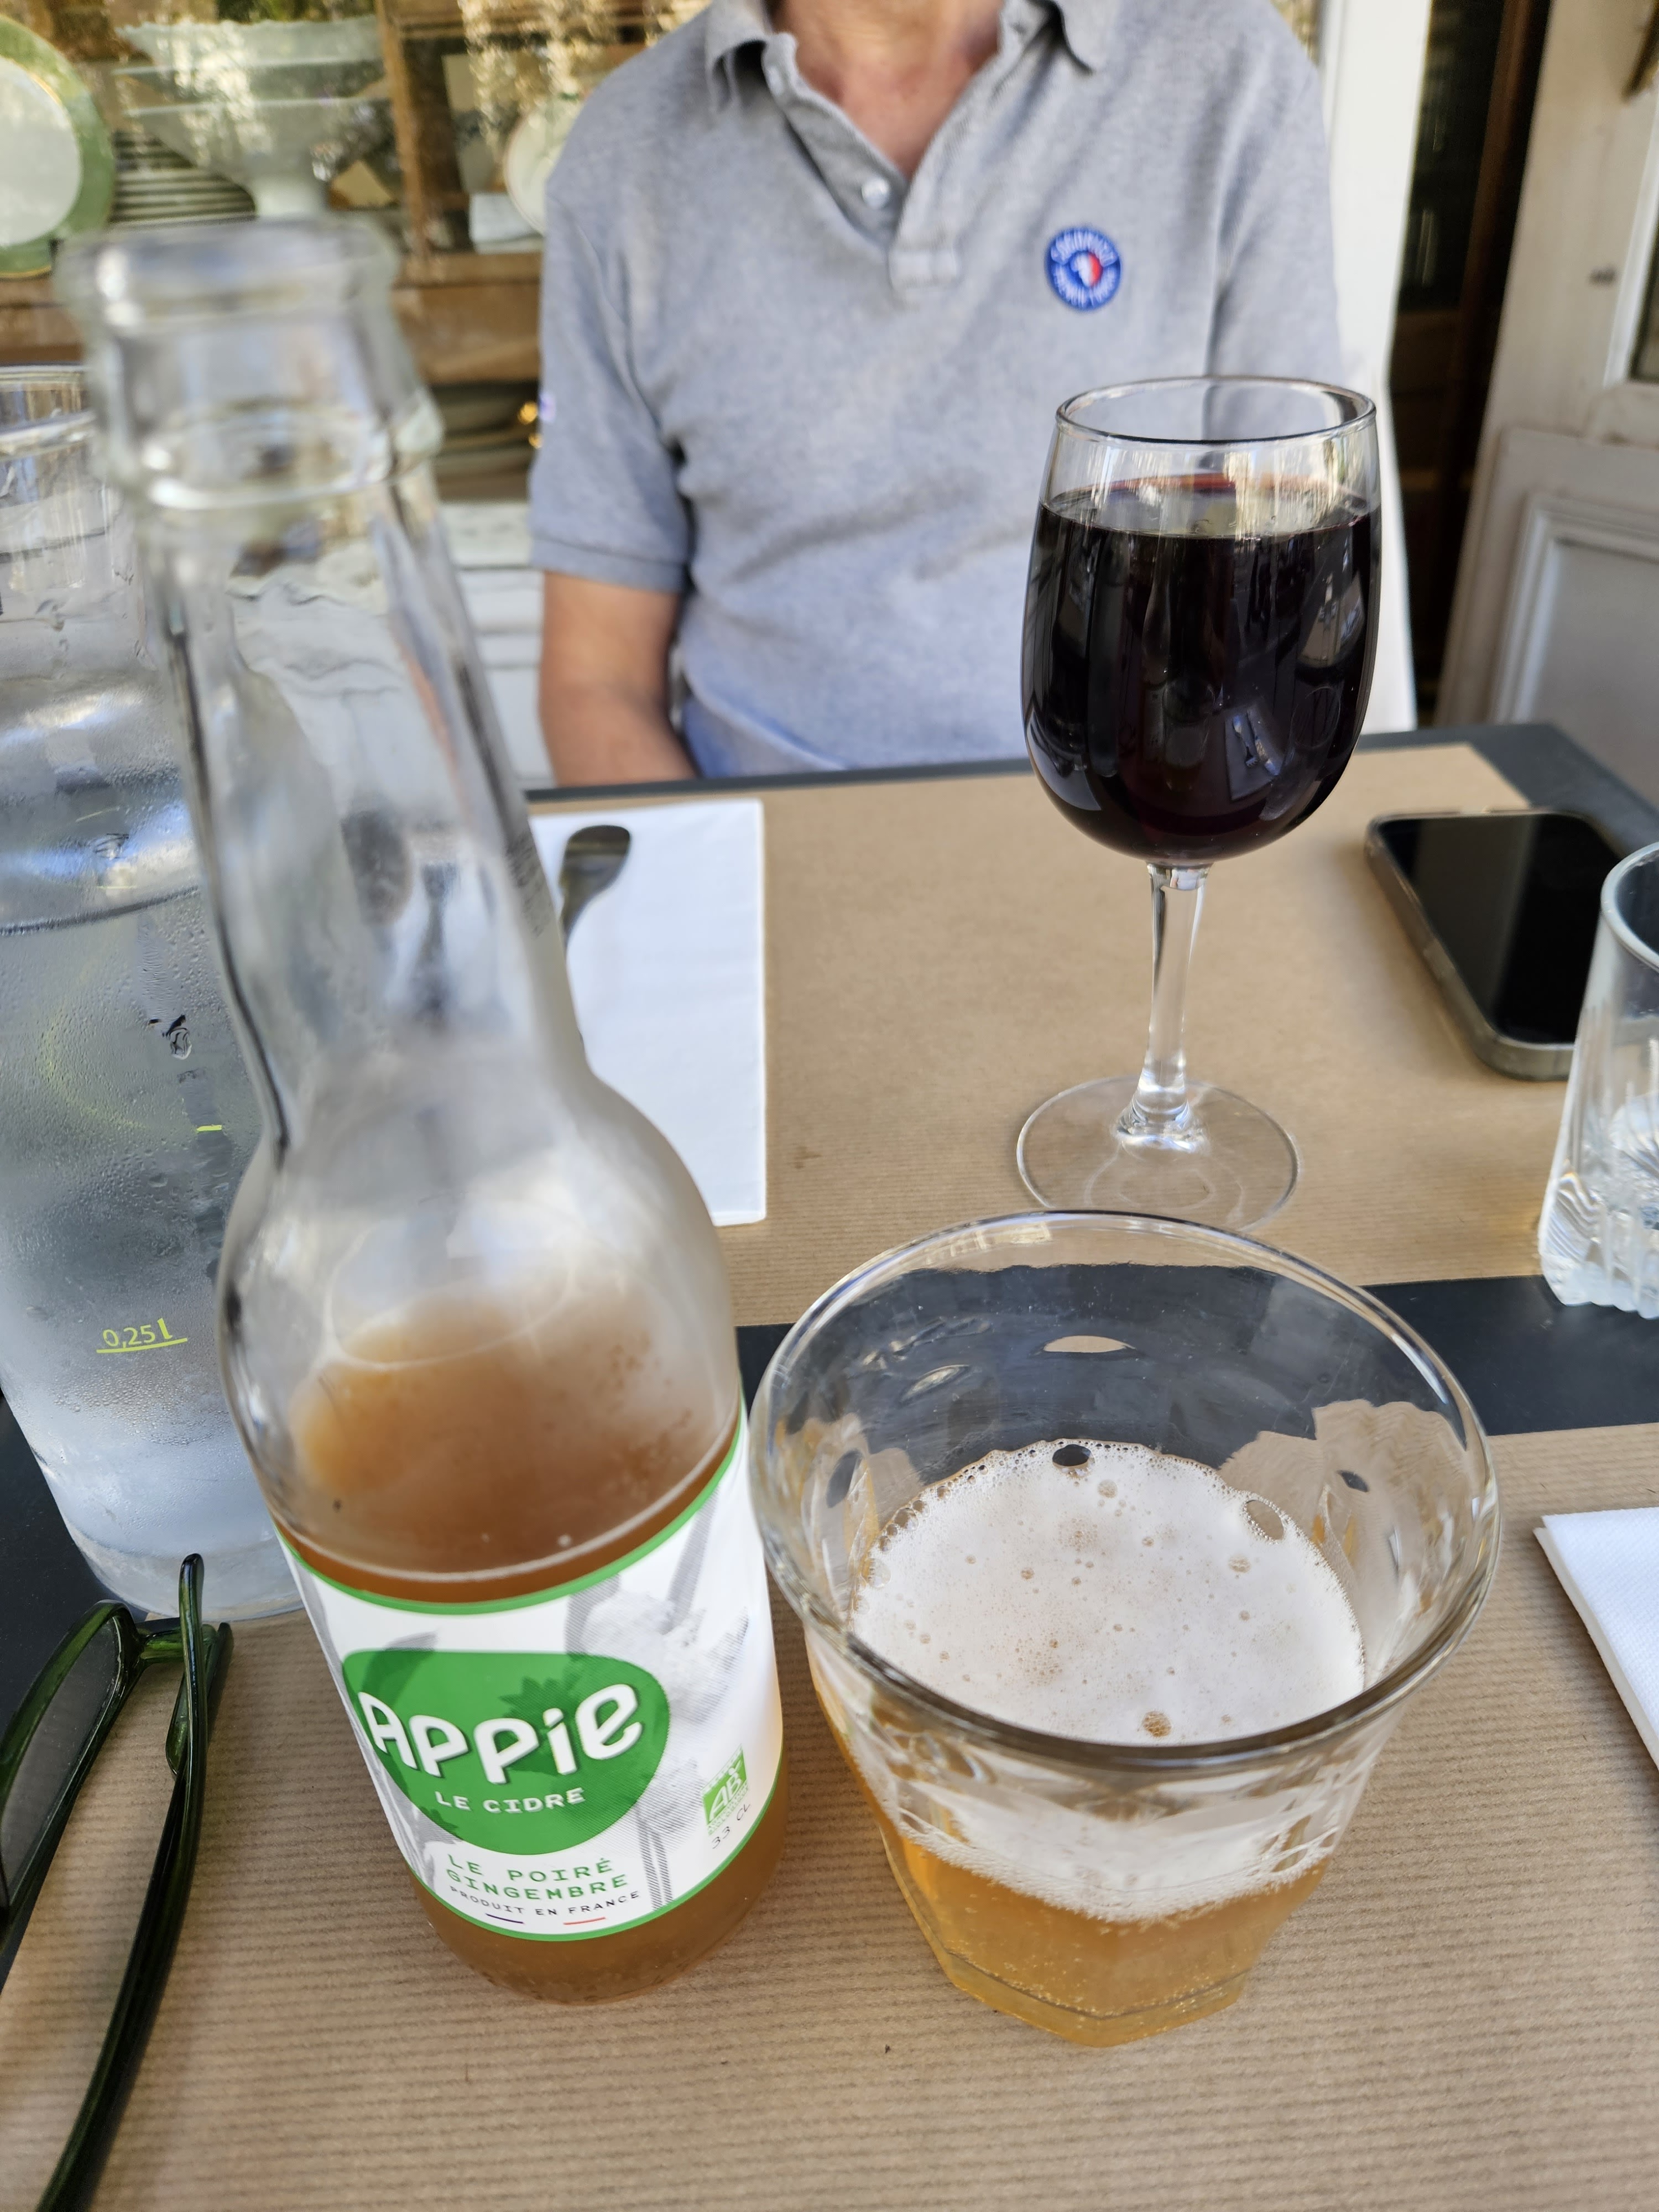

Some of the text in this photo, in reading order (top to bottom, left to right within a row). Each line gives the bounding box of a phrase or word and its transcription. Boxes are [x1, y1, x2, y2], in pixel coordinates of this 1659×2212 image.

[435, 1787, 586, 1814] LE CIDRE
[712, 1826, 731, 1849] 33
[447, 1854, 613, 1882] LE POIRÉ
[446, 1869, 628, 1900] GINGEMBRE
[450, 1885, 526, 1914] PRODUIT
[568, 1891, 640, 1914] FRANCE
